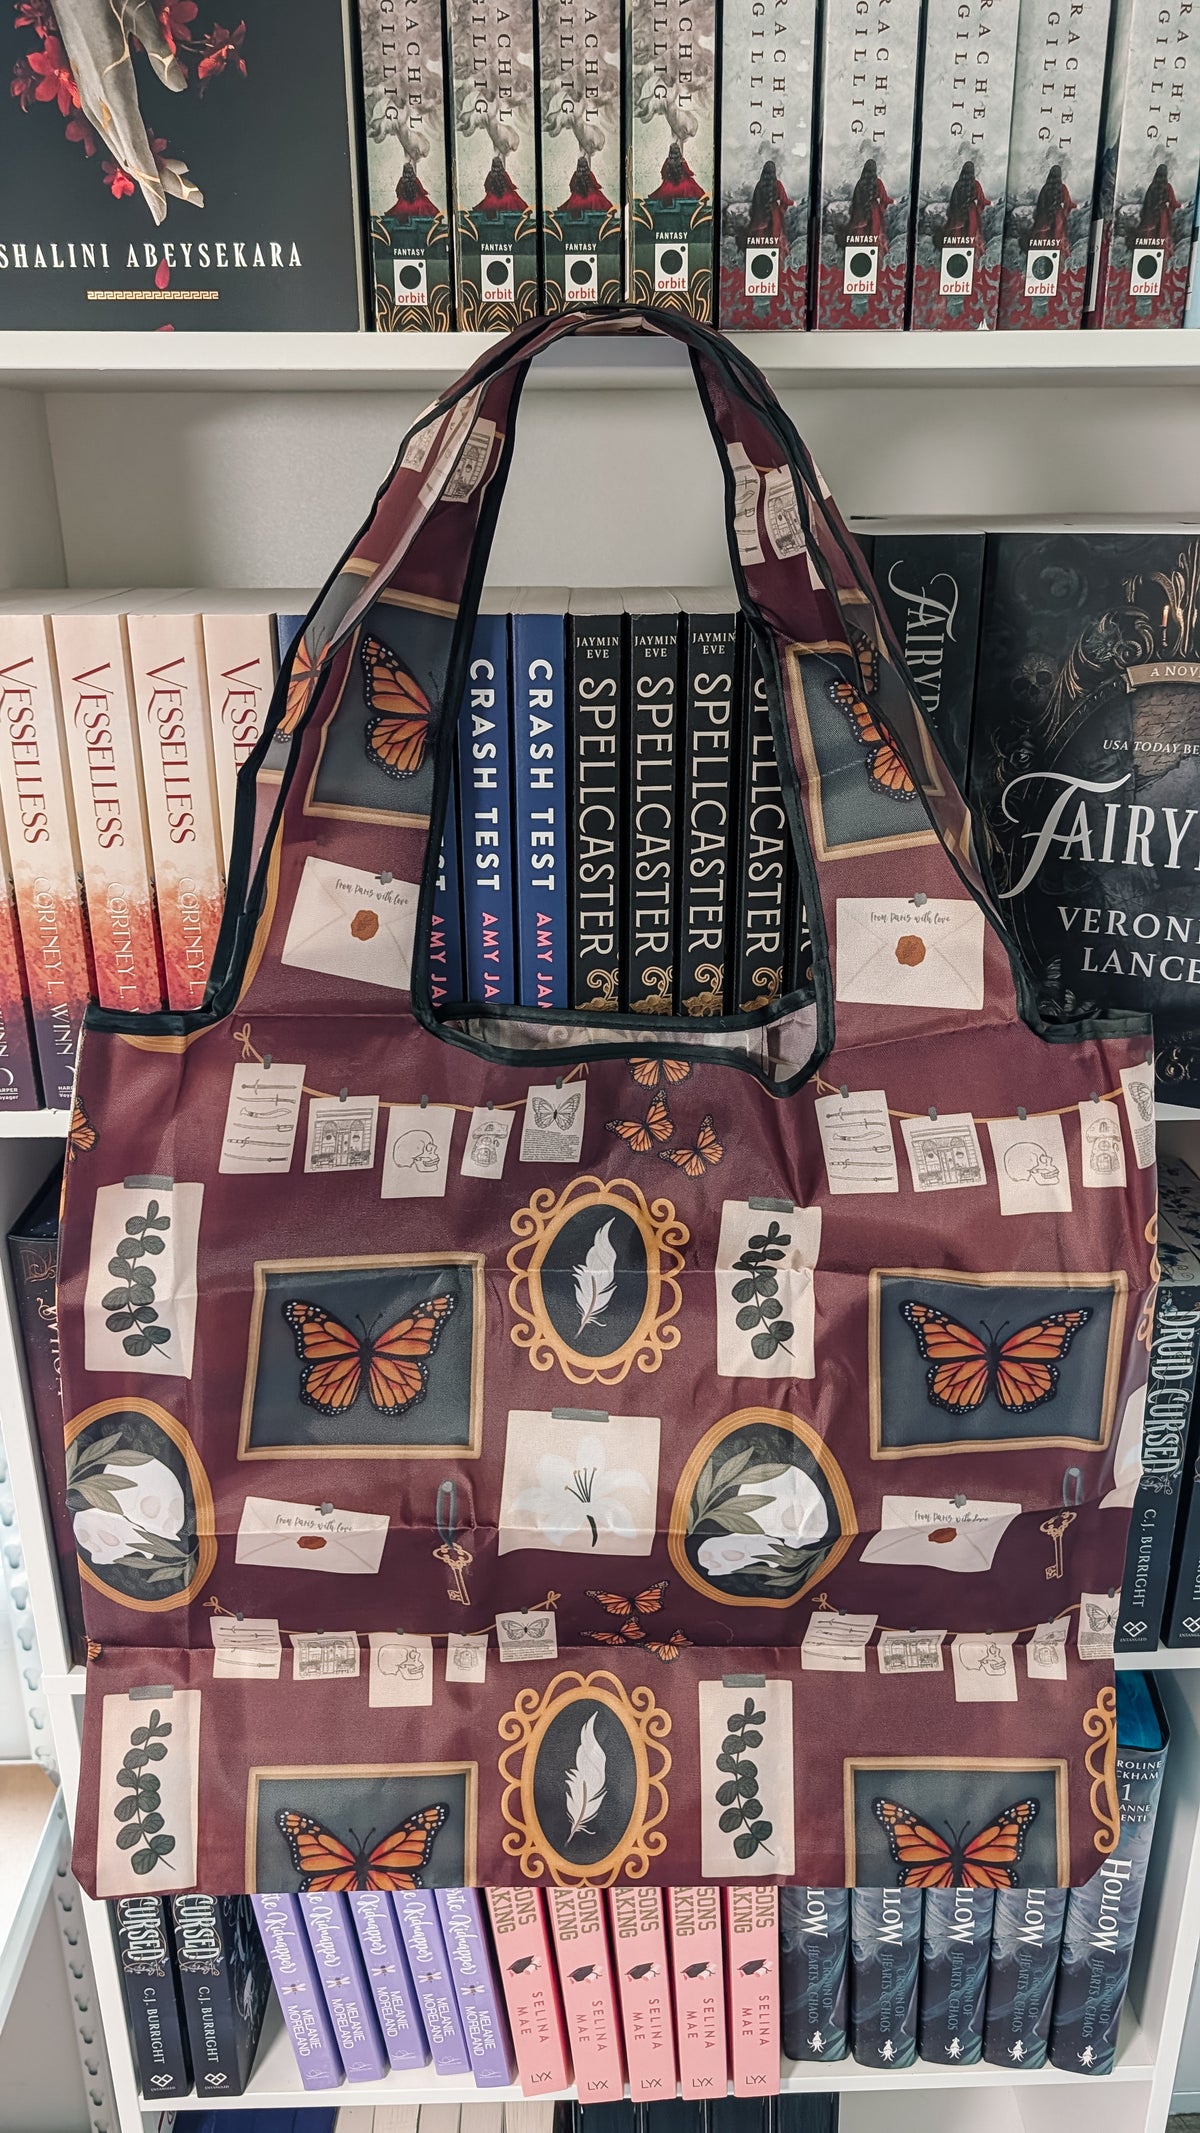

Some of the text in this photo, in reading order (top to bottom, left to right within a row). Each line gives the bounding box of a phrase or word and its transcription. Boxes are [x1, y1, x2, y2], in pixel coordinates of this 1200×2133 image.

[380, 0, 399, 121] GILLIG
[497, 8, 513, 122] ACHEL
[584, 9, 599, 122] ACHEL
[653, 0, 668, 100] ILLIG
[750, 2, 765, 136] GILLIG
[770, 0, 787, 144] RACHEL
[851, 1, 869, 134] GILLIG
[950, 4, 971, 137] GILLIG
[971, 0, 993, 145] RACHEL
[1038, 11, 1060, 141] GILLIG
[1059, 3, 1084, 149] RACHEL
[1147, 10, 1171, 139] GILLIG
[1166, 1, 1193, 148] RACHEL
[0, 242, 303, 269] SHALINI ABEYSEKARA
[393, 248, 425, 256] FANTASY
[481, 243, 513, 252] FANTASY
[565, 243, 597, 251] FANTASY
[655, 232, 688, 240] FANTASY
[747, 236, 779, 245] FANTASY
[846, 234, 878, 244] FANTASY
[943, 236, 975, 245] FANTASY
[1029, 238, 1061, 247] FANTASY
[1135, 238, 1166, 246] FANTASY
[398, 292, 425, 304] orbit
[484, 289, 512, 300] orbit
[567, 288, 596, 299] orbit
[657, 277, 686, 289] orbit
[747, 281, 776, 294] orbit
[846, 279, 875, 292] orbit
[942, 280, 970, 293] orbit
[1027, 282, 1055, 295] orbit
[1132, 281, 1159, 294] orbit
[576, 636, 620, 648] JAYMIN
[587, 650, 609, 659] EVE
[634, 635, 678, 646] JAYMIN
[645, 648, 667, 657] EVE
[692, 632, 736, 644] JAYMIN
[703, 645, 725, 654] EVE
[1150, 666, 1200, 678] A NOV
[528, 658, 554, 789] CRASH
[1103, 740, 1128, 750] USA
[1133, 741, 1181, 753] TODAY
[0, 656, 50, 844] VESSELLESS
[71, 662, 125, 849] VESSELLESS
[146, 656, 196, 844] VESSELLESS
[470, 658, 500, 1004] CRASH TEST AMY JA
[578, 677, 617, 959] SPELLCASTER
[635, 676, 675, 956] SPELLCASTER
[688, 672, 732, 953] SPELLCASTER
[998, 771, 1200, 899] FAIRY
[530, 807, 555, 891] TEST
[107, 882, 136, 999] CORTNEY L.
[178, 877, 206, 995] CORTNEY L.
[536, 912, 553, 963] AMY
[33, 877, 74, 1055] CORTNEY L. WINN
[1151, 1310, 1200, 1381] DRUID
[1132, 1535, 1153, 1608] BURRIGHT
[1117, 1760, 1163, 1770] ROLINE
[1119, 1803, 1151, 1812] ANNE
[1121, 1783, 1131, 1801] 1
[1121, 1814, 1147, 1822] ENTI
[118, 1895, 166, 1962] CURSED
[174, 1894, 220, 1961] CURSED
[357, 1894, 387, 1956] Kidnapper
[577, 1888, 600, 1934] SONS
[638, 1887, 660, 1932] SONS
[697, 1887, 717, 1931] SONS
[1089, 1858, 1133, 1955] HOLLOW
[264, 1912, 297, 1974] Kidnapper
[309, 1906, 341, 1967] Kidnapper
[403, 1902, 433, 1962] Kidnapper
[448, 1915, 479, 1975] Kidnapper
[201, 2006, 219, 2063] BURRIGHT
[287, 2005, 311, 2057] MORELAND
[301, 2009, 321, 2049] MELANIE
[331, 1999, 354, 2049] MORELAND
[345, 2002, 365, 2042] MELANIE
[376, 1987, 398, 2038] MORELAND
[390, 1991, 409, 2030] MELANIE
[423, 1993, 444, 2044] MORELAND
[436, 1997, 455, 2037] MELANIE
[464, 2006, 484, 2056] MORELAND
[478, 2010, 496, 2050] MELANIE
[516, 2006, 532, 2035] MAE
[532, 1991, 549, 2043] SELINA
[576, 2014, 590, 2043] MAE
[592, 2000, 607, 2051] SELINA
[632, 2012, 645, 2041] MAE
[648, 1998, 663, 2050] SELINA
[686, 2011, 698, 2039] MAE
[703, 1998, 715, 2049] SELINA
[741, 2008, 753, 2036] MAE
[758, 1995, 770, 2046] SELINA
[146, 2008, 165, 2064] BURRIGHT
[531, 2071, 553, 2083] LYX
[587, 2080, 609, 2091] LYX
[641, 2078, 662, 2089] LYX
[692, 2077, 714, 2088] LYX
[745, 2075, 767, 2085] LYX
